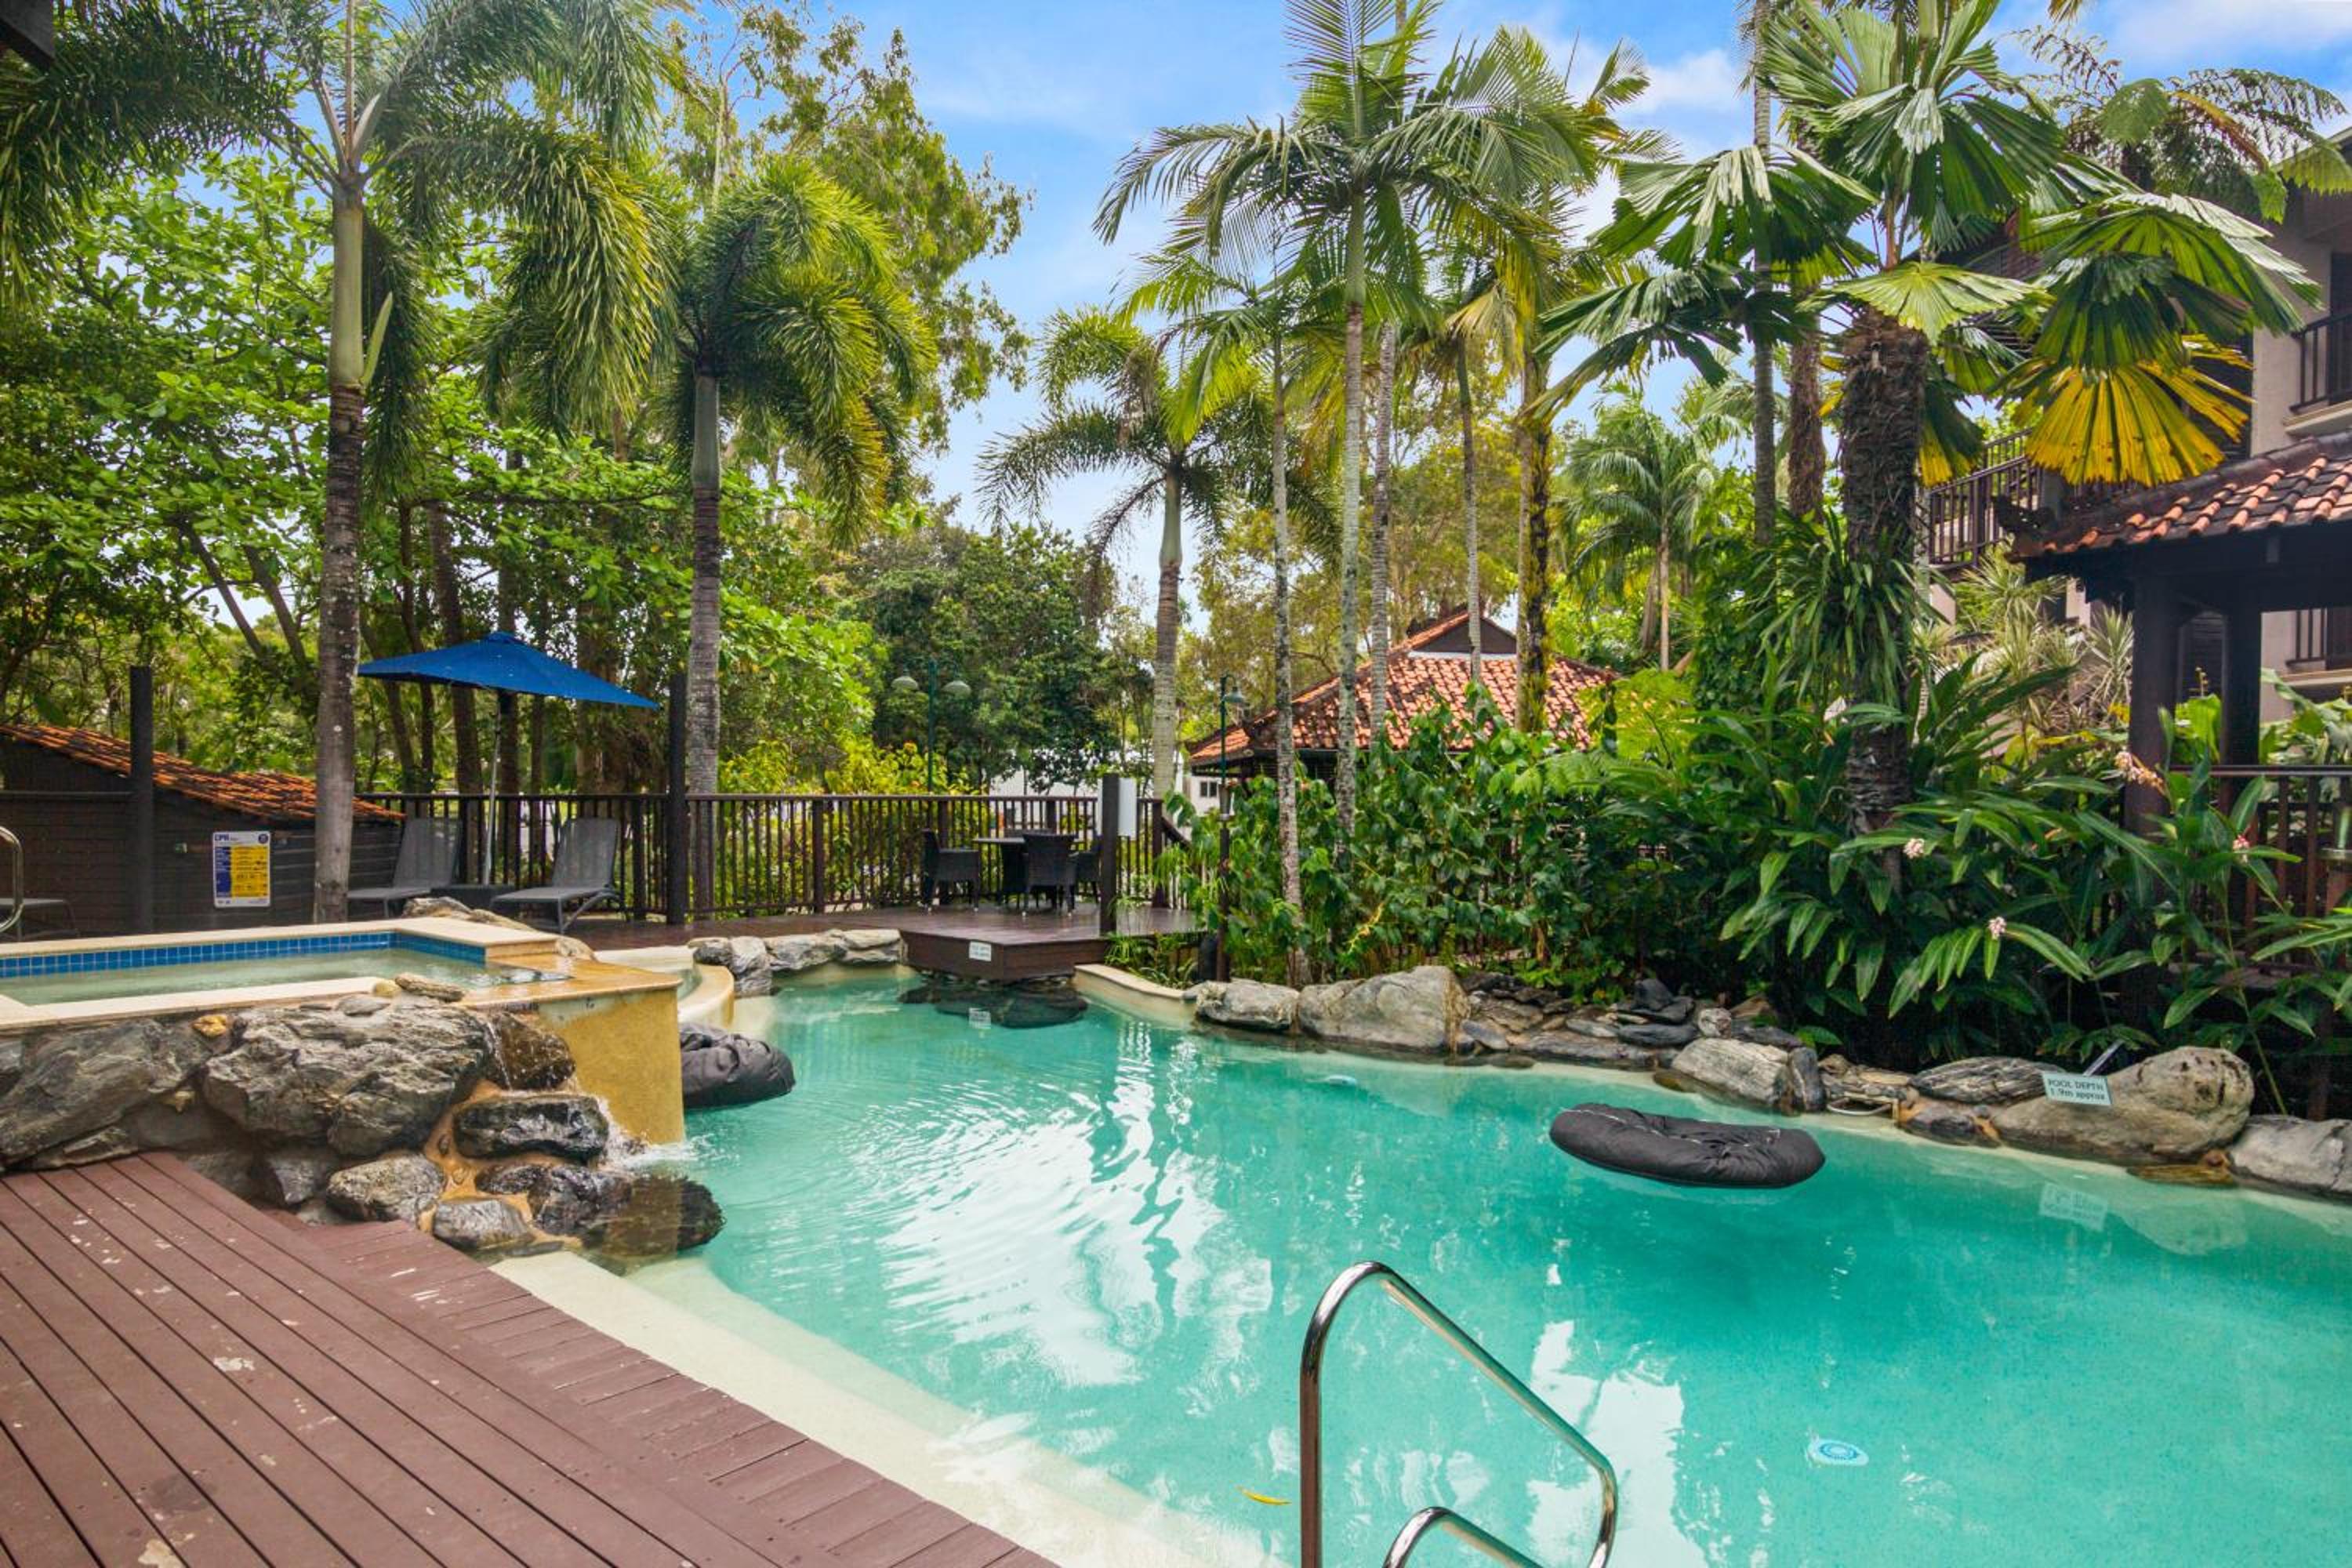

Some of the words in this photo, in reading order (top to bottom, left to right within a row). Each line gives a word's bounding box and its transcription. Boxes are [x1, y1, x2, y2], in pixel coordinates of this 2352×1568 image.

[2048, 1079, 2072, 1089] POOL
[2074, 1081, 2105, 1091] DEPTH
[2076, 1091, 2105, 1100] approx
